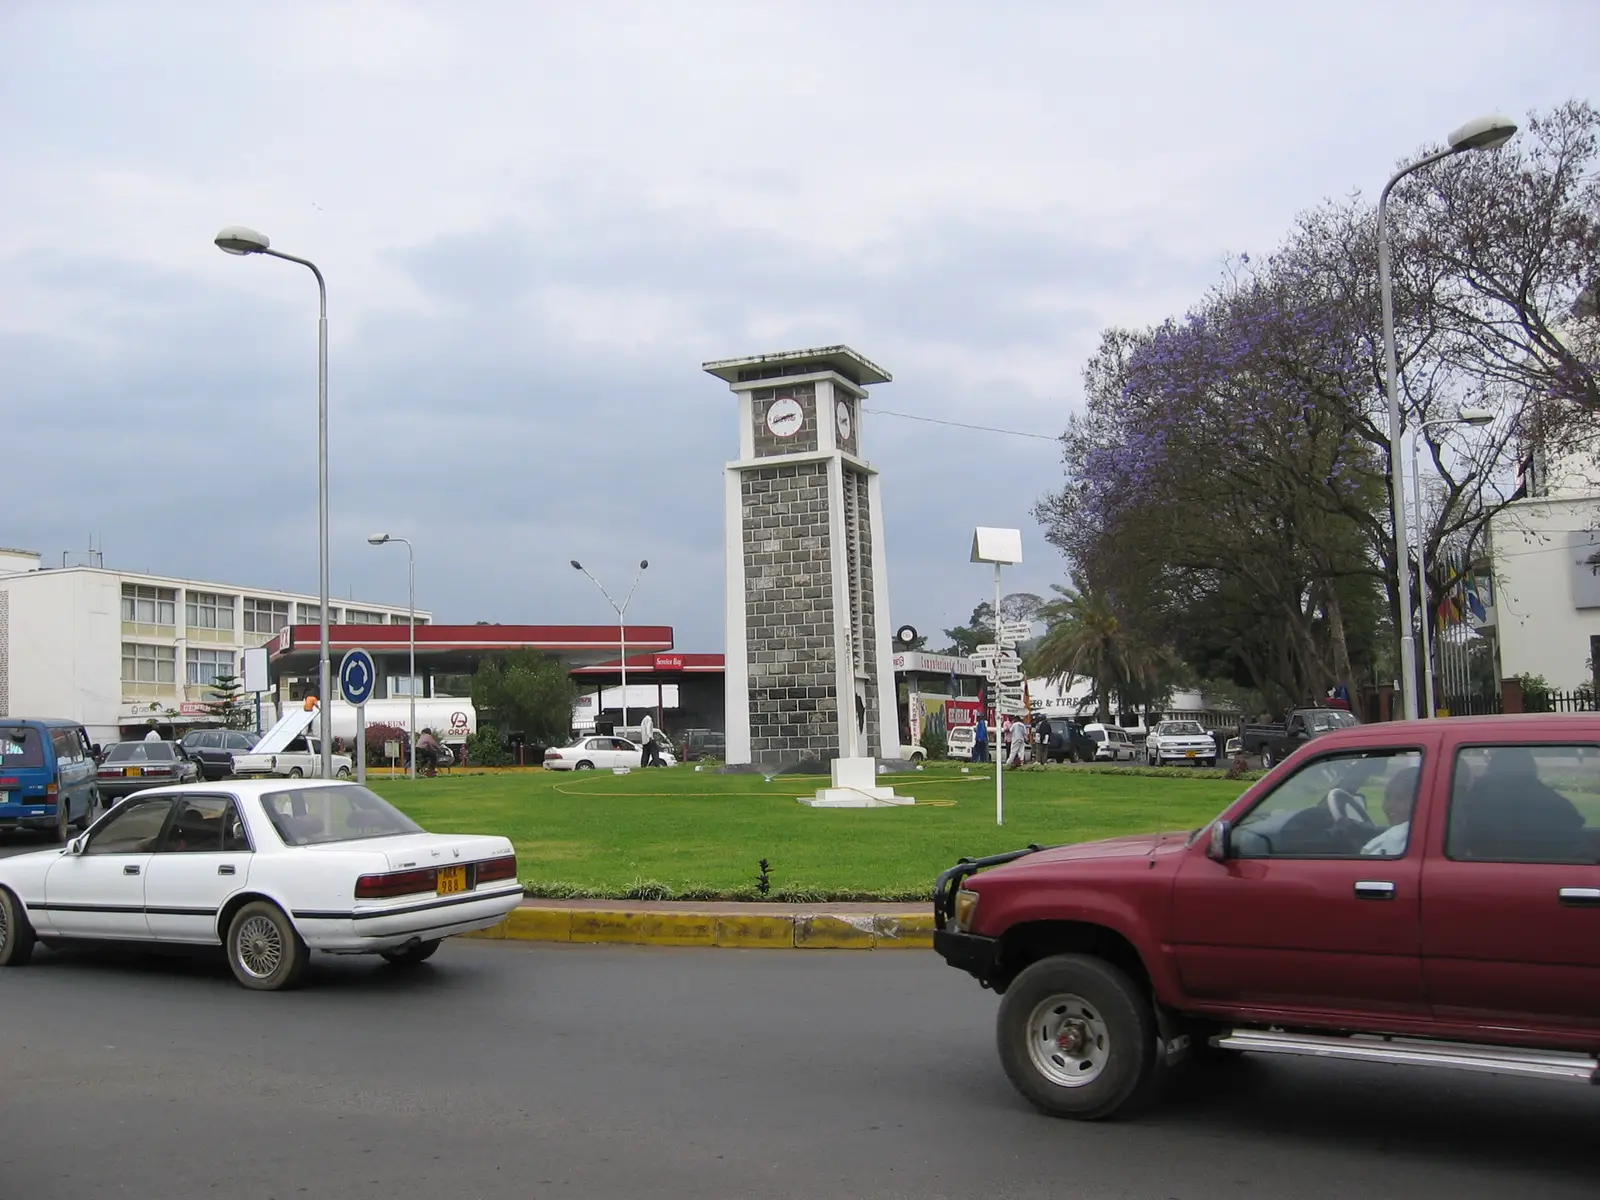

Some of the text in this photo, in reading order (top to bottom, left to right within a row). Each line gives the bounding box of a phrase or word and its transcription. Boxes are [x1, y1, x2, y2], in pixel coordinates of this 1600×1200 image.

[656, 657, 682, 666] Service Bay
[1046, 698, 1053, 707] &
[1055, 697, 1080, 707] TYRE
[448, 728, 471, 736] ORYX
[442, 879, 459, 893] 988
